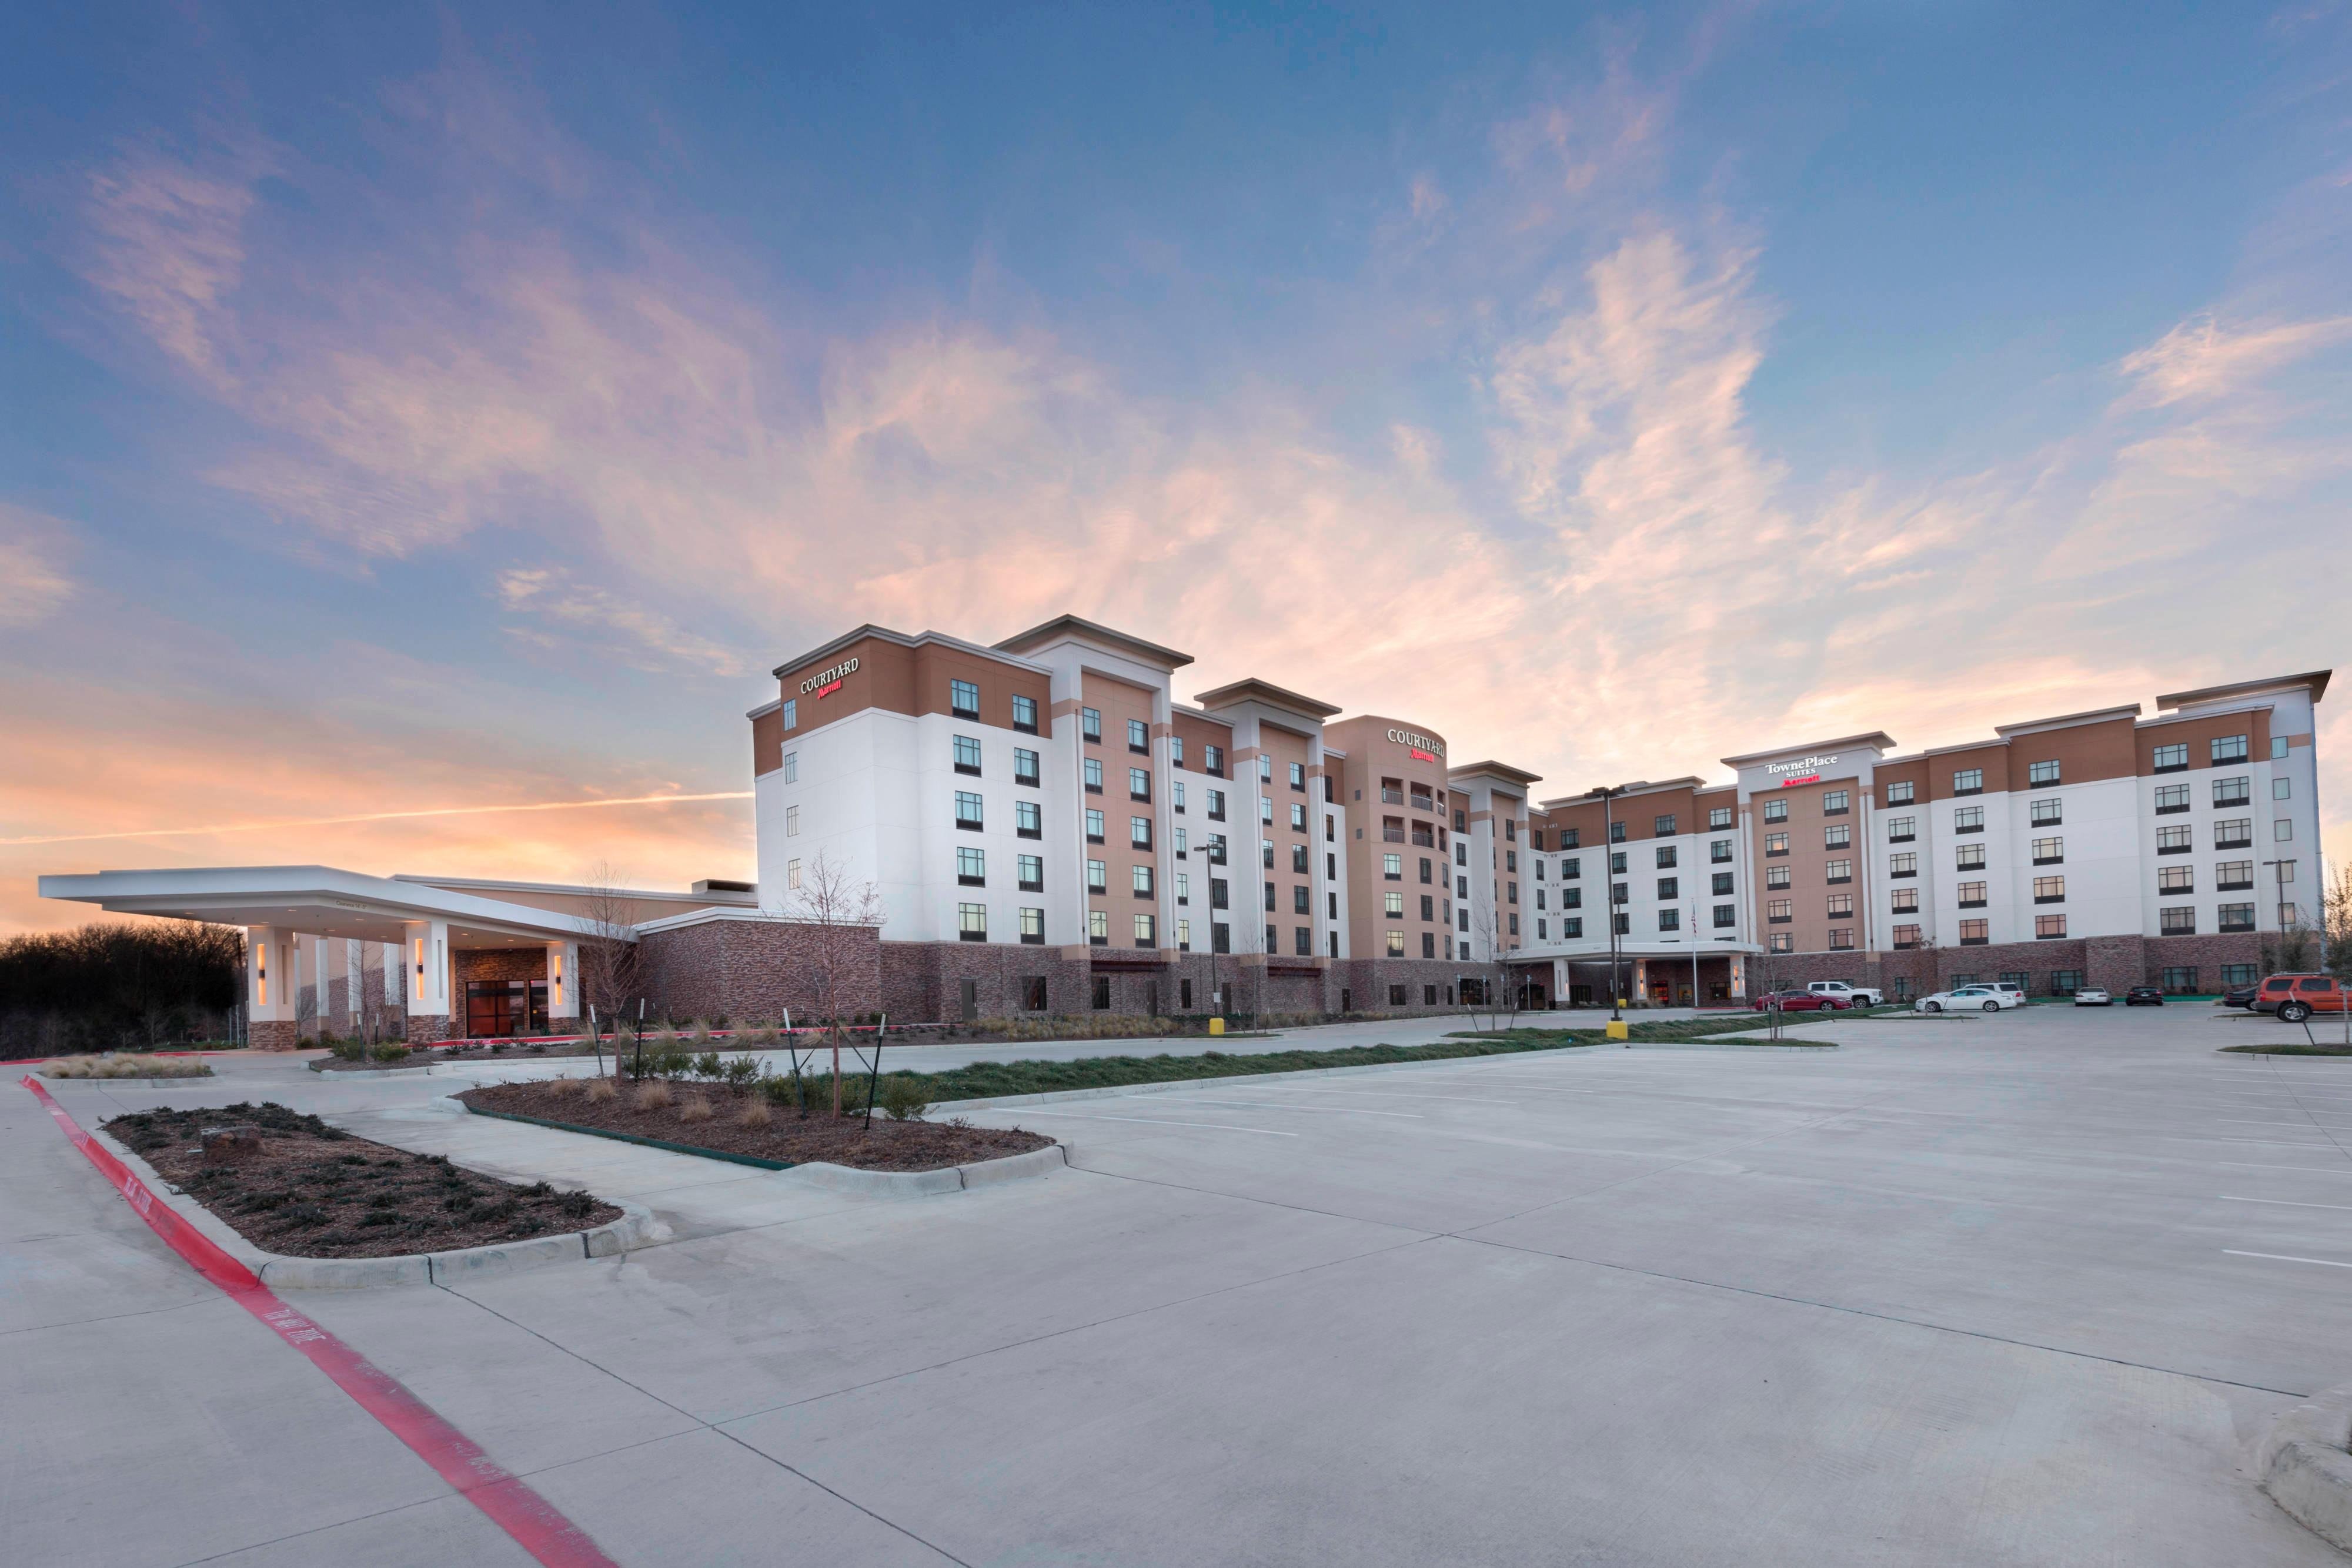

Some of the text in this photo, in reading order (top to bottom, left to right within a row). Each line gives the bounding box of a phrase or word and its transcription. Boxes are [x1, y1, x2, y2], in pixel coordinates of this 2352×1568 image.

[800, 657, 859, 694] COURTYARD
[817, 679, 842, 700] Marriott
[1387, 728, 1445, 758] COURTYARD
[1411, 748, 1434, 763] Marriott
[1765, 756, 1838, 774] TownePlace
[1786, 768, 1816, 778] SUITES
[1782, 774, 1820, 788] Marriott
